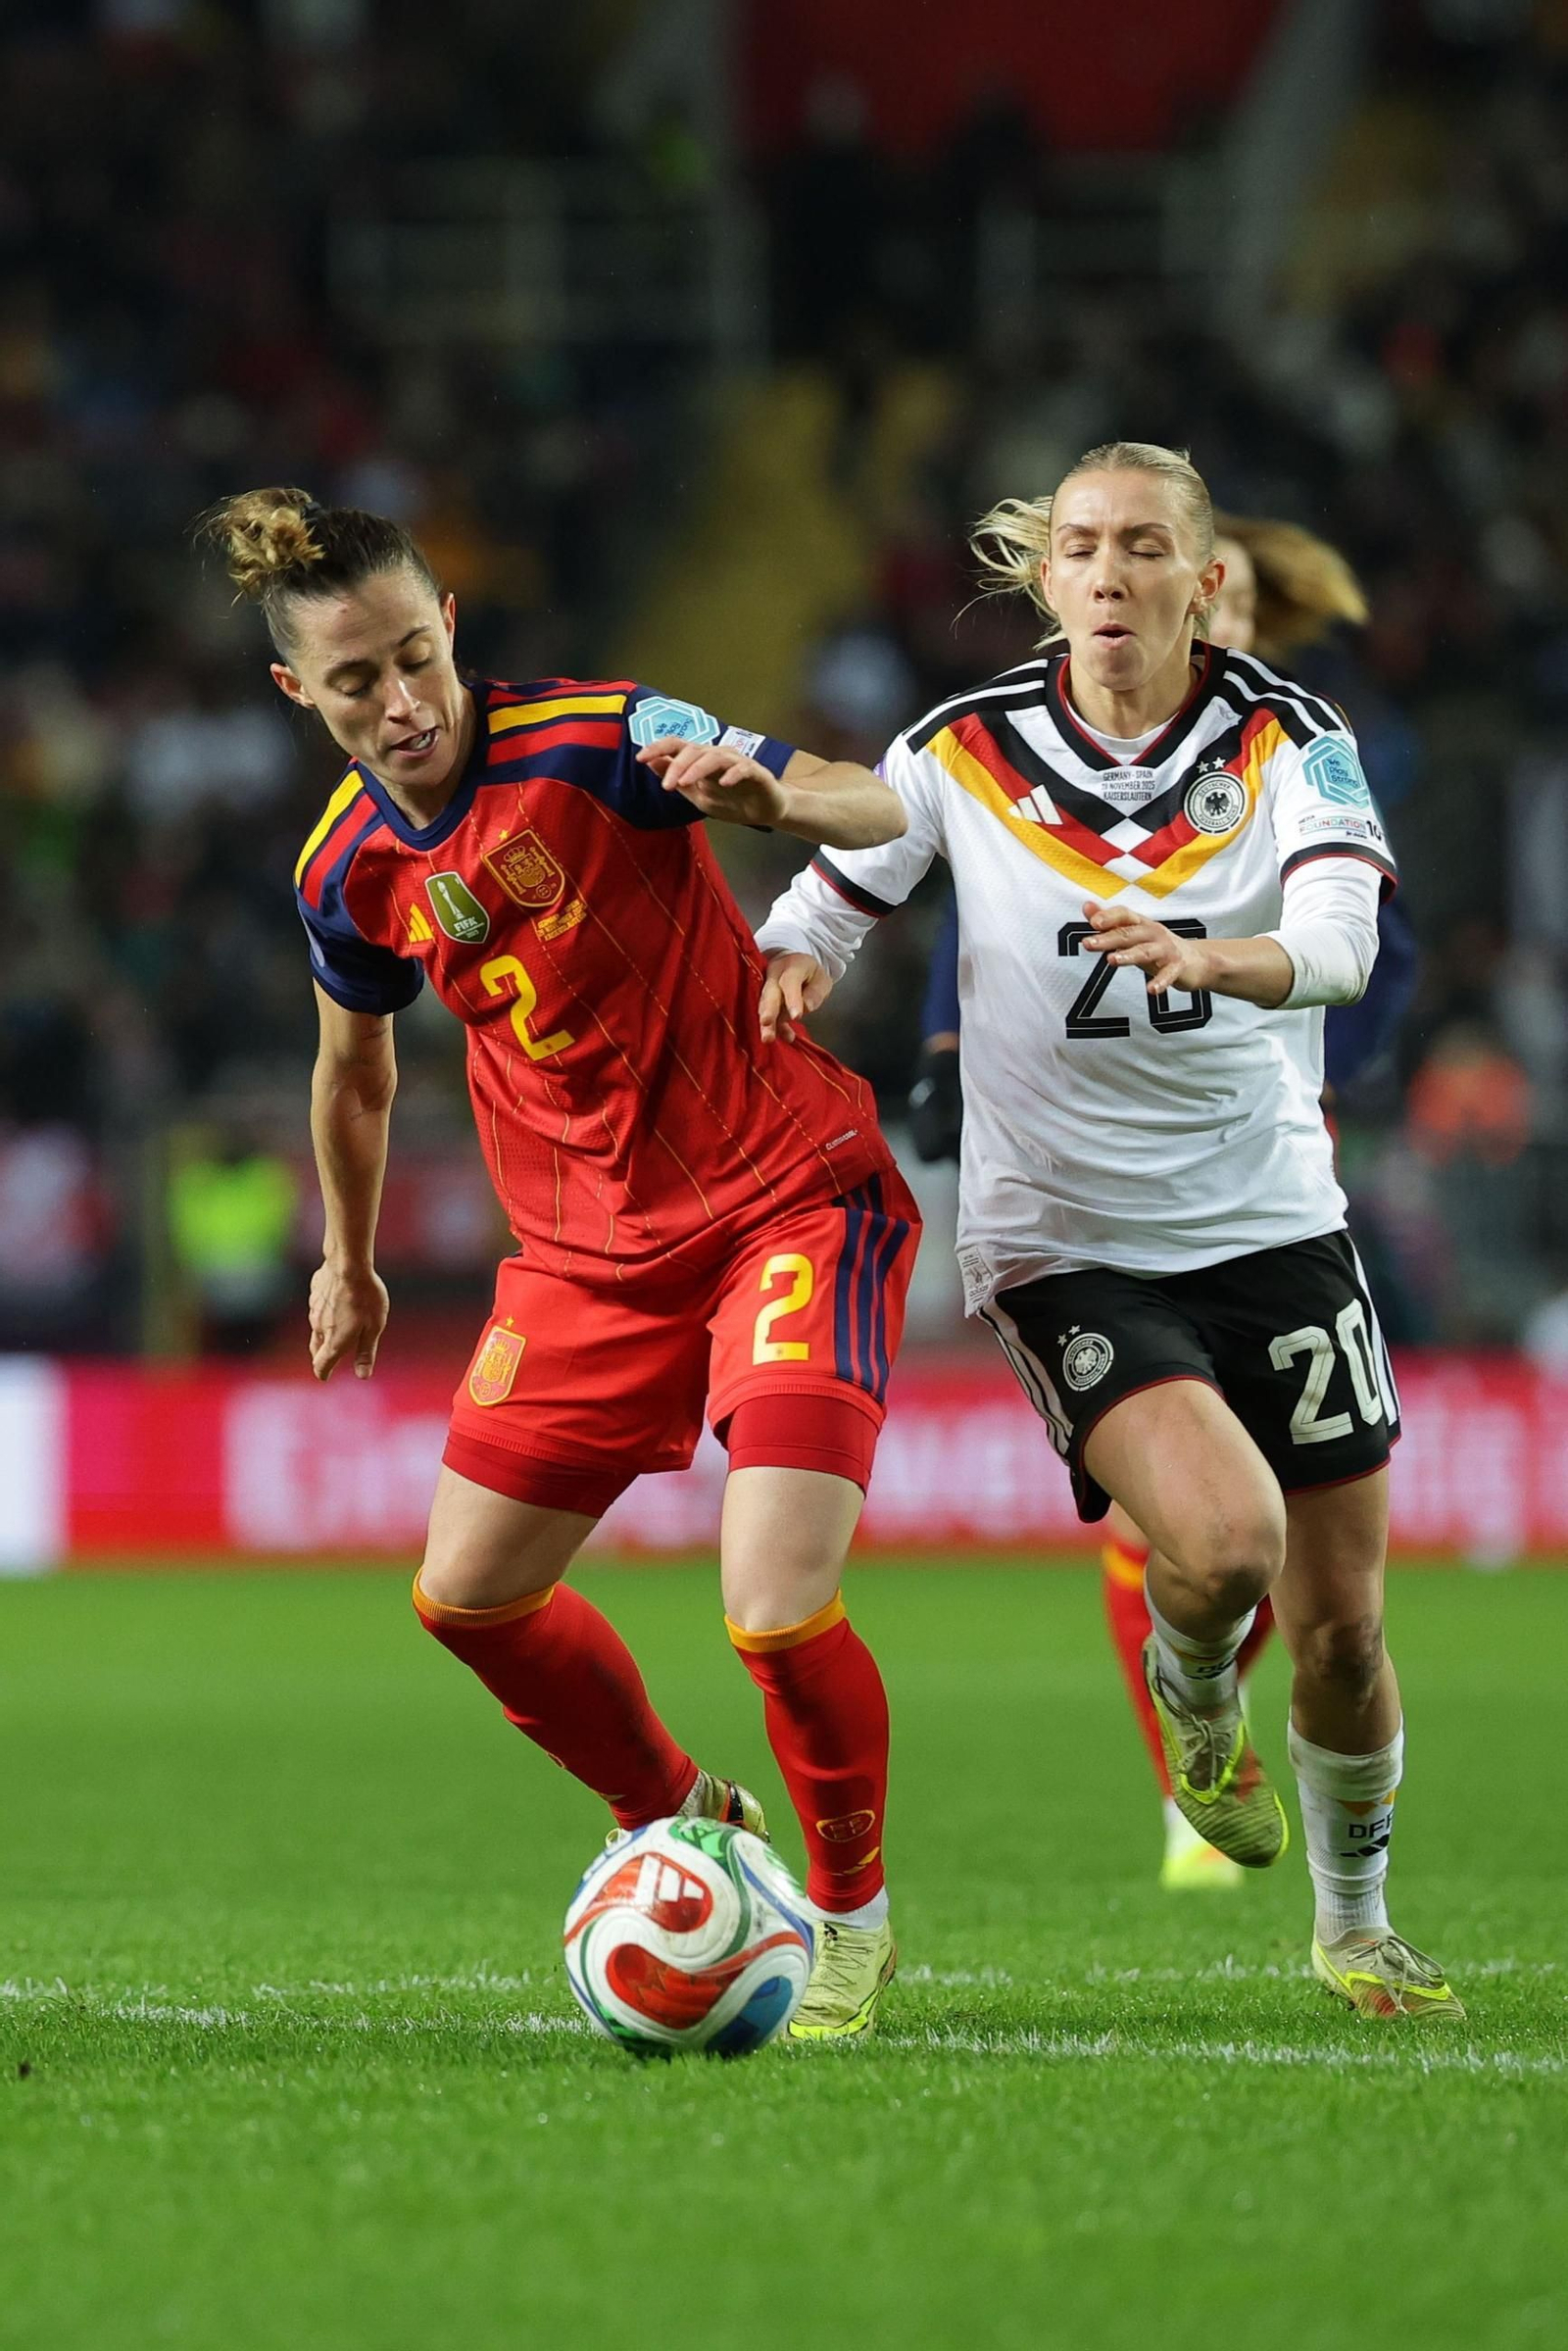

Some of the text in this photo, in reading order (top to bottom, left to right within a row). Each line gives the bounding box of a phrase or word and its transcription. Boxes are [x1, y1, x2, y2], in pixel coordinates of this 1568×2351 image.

[1103, 771, 1131, 782] GERMANY
[1109, 780, 1141, 791] NOVEMBER
[454, 916, 479, 932] FIFA
[480, 955, 575, 1060] 2
[753, 1252, 814, 1366] 2
[1268, 1298, 1384, 1445] 20
